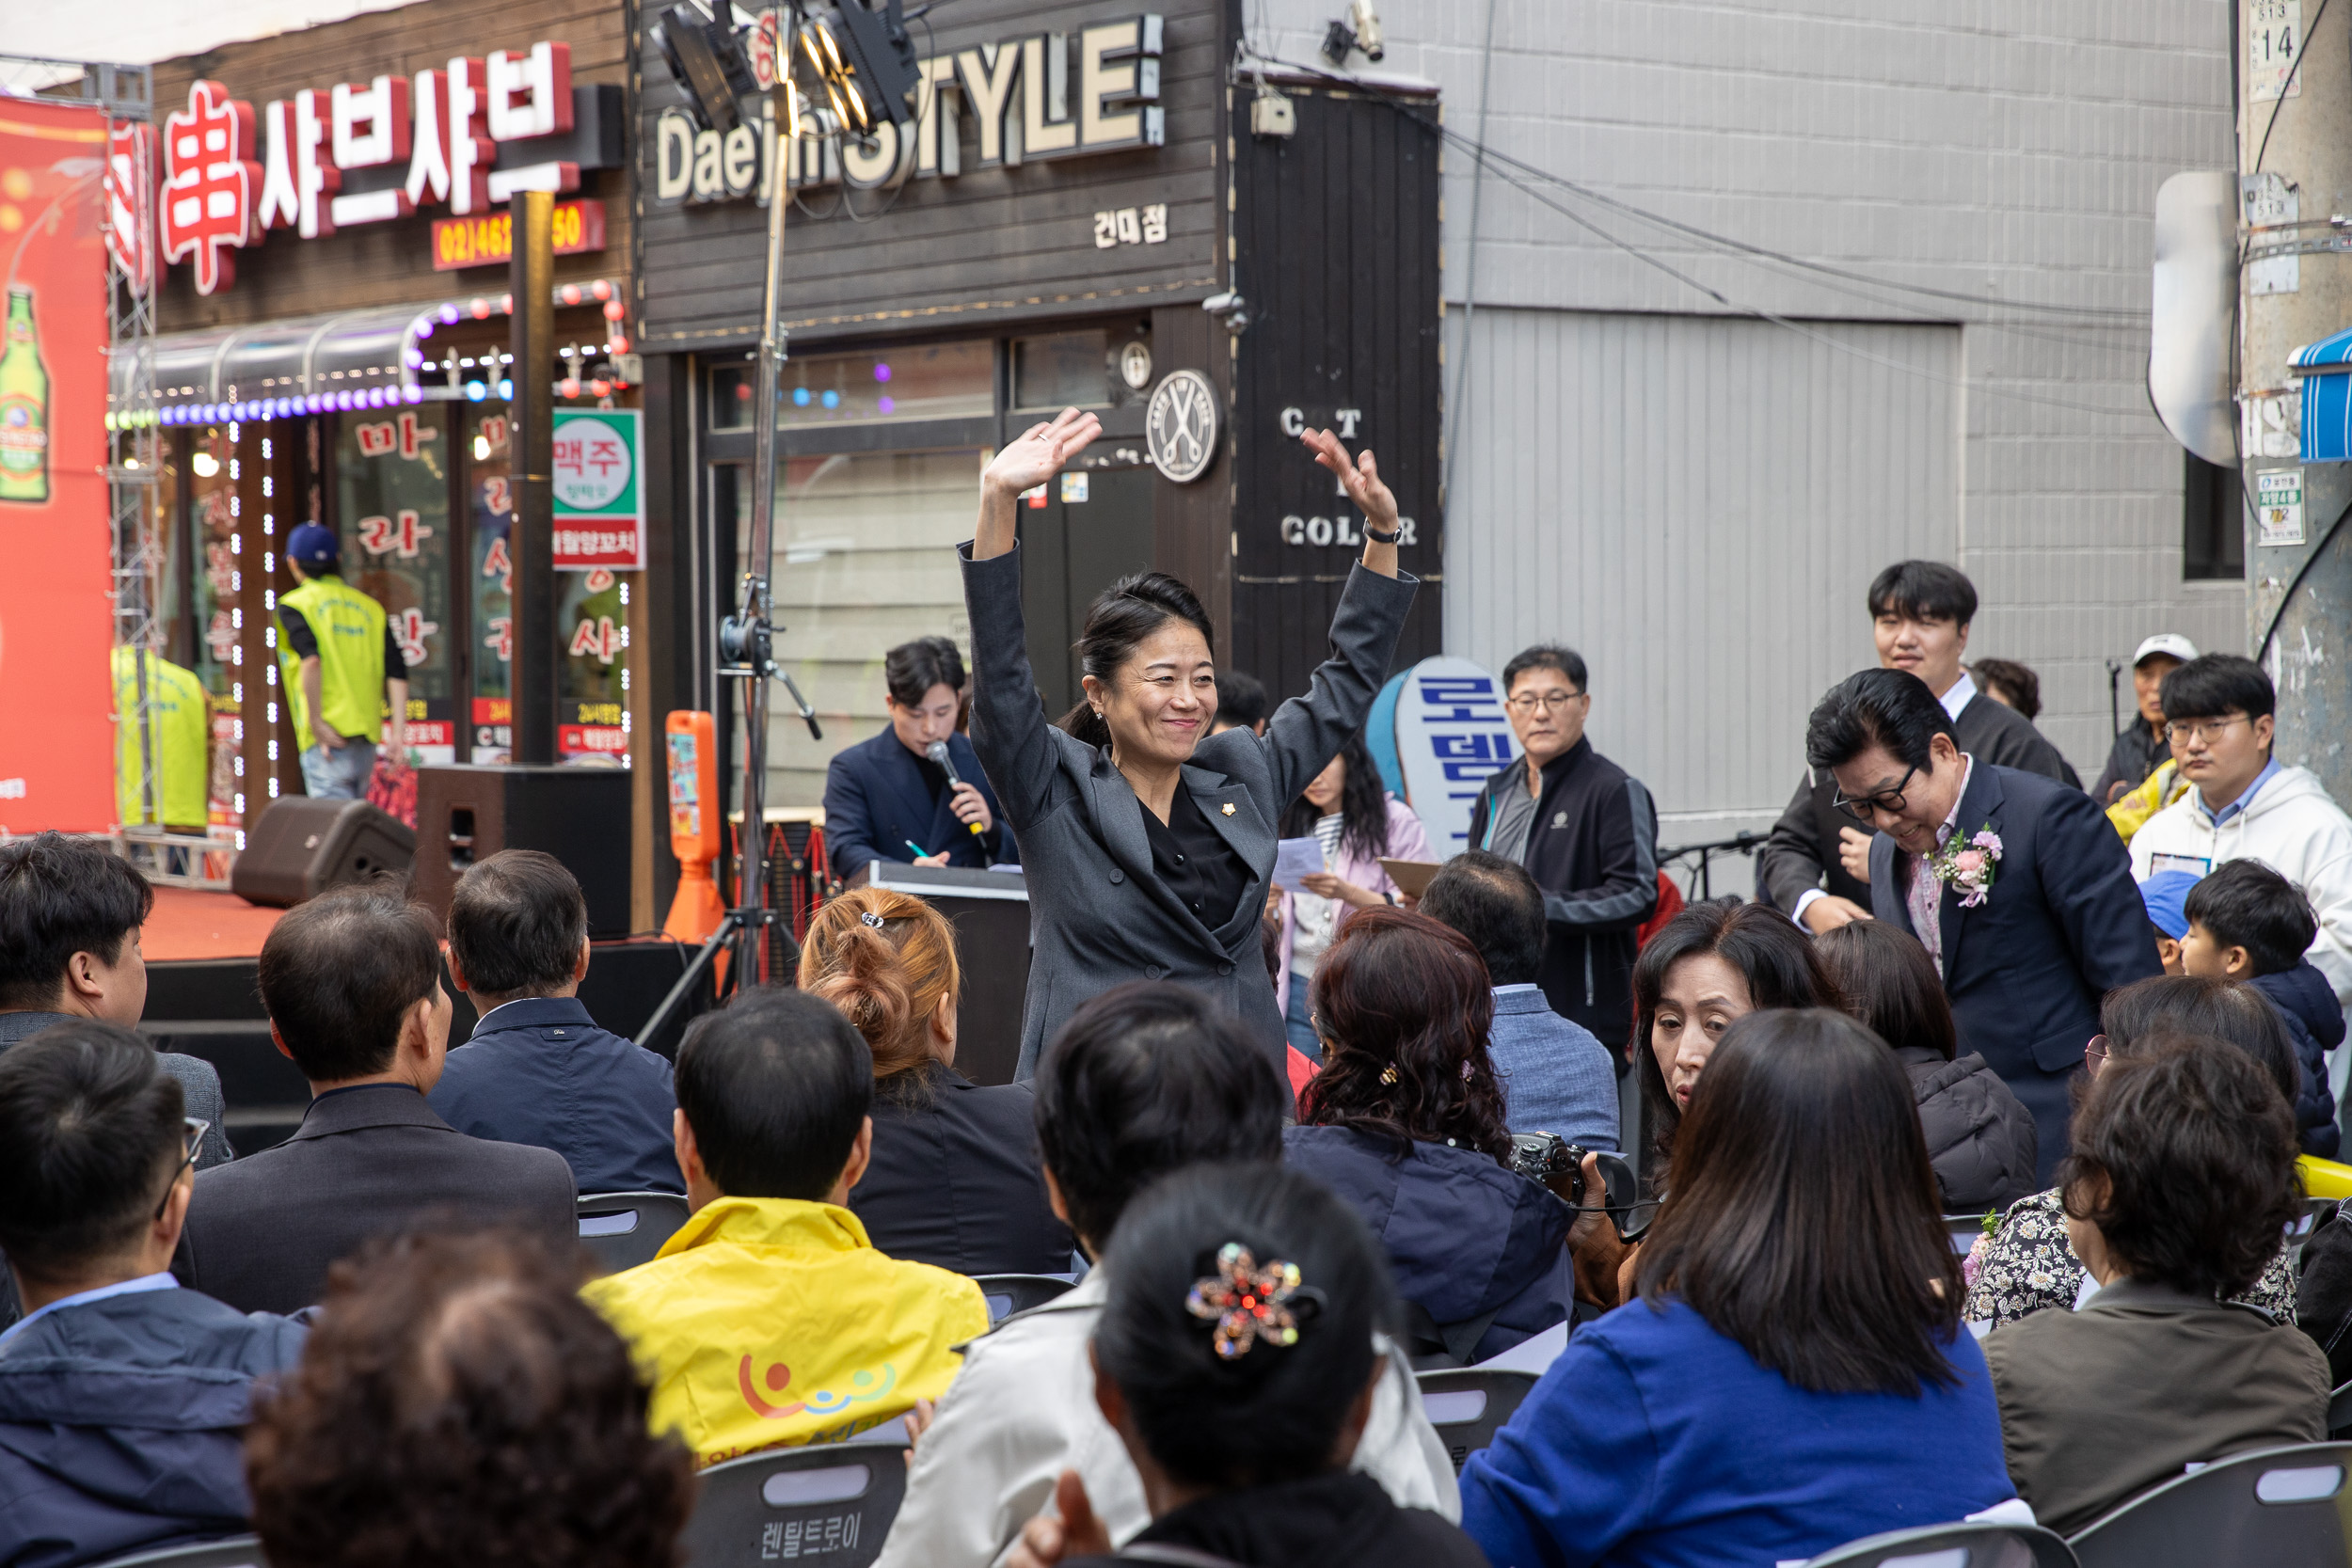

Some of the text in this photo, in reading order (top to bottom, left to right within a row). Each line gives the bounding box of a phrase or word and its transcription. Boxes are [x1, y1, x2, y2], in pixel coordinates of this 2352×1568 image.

[2259, 4, 2285, 21] 513
[2262, 24, 2293, 61] 14
[259, 40, 571, 239] 샤브샤브
[658, 98, 820, 200] Daejn
[161, 81, 251, 296] 串
[1093, 202, 1167, 249] 건대점
[1279, 406, 1361, 439] CT
[552, 438, 622, 477] 맥주
[1280, 515, 1418, 546] COLR
[761, 1511, 862, 1560] 렌탈트로이
